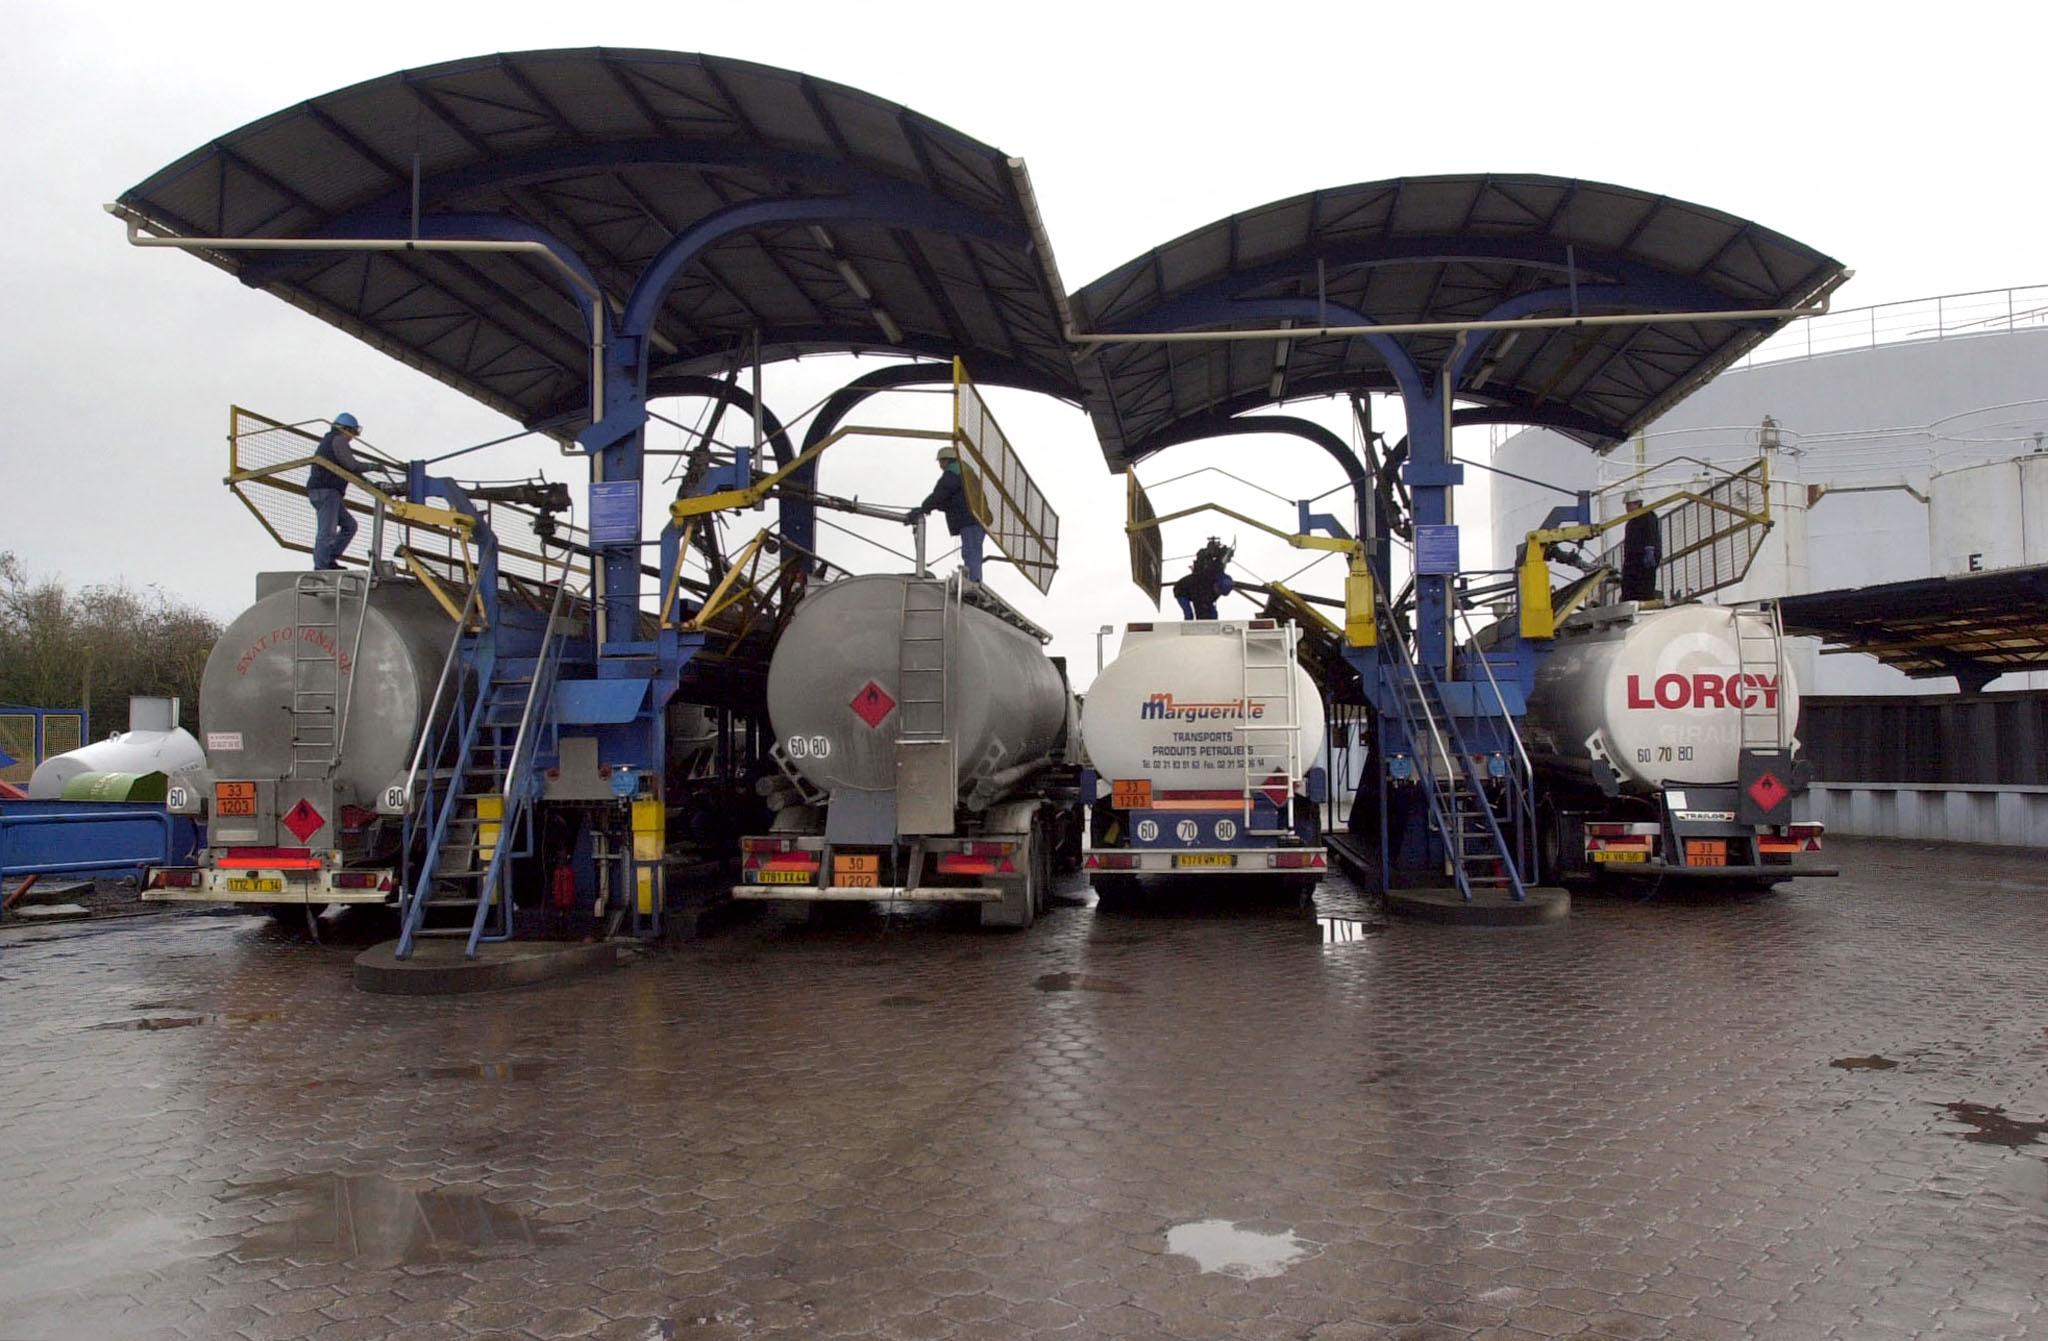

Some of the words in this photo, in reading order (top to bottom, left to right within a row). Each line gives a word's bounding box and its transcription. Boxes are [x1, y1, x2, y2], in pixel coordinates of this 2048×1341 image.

[1968, 553, 1983, 571] E
[1627, 673, 1780, 709] LORCY
[1173, 732, 1233, 742] TRANSPORTS
[790, 738, 805, 756] 60
[812, 738, 827, 756] 80
[1152, 746, 1197, 757] PRODUITS
[1637, 748, 1651, 763] 60
[1658, 747, 1672, 762] 70
[1678, 746, 1693, 761] 80
[228, 784, 242, 797] 33
[1127, 782, 1138, 794] 33
[170, 789, 184, 807] 60
[389, 789, 404, 807] 80
[1120, 796, 1145, 807] 1203
[222, 800, 249, 813] 1203
[1140, 822, 1155, 839] 60
[1181, 822, 1195, 839] 70
[1218, 822, 1233, 839] 80
[1700, 842, 1713, 854] 33
[848, 857, 864, 870] 30
[1693, 857, 1719, 867] 1203
[841, 875, 872, 888] 1202
